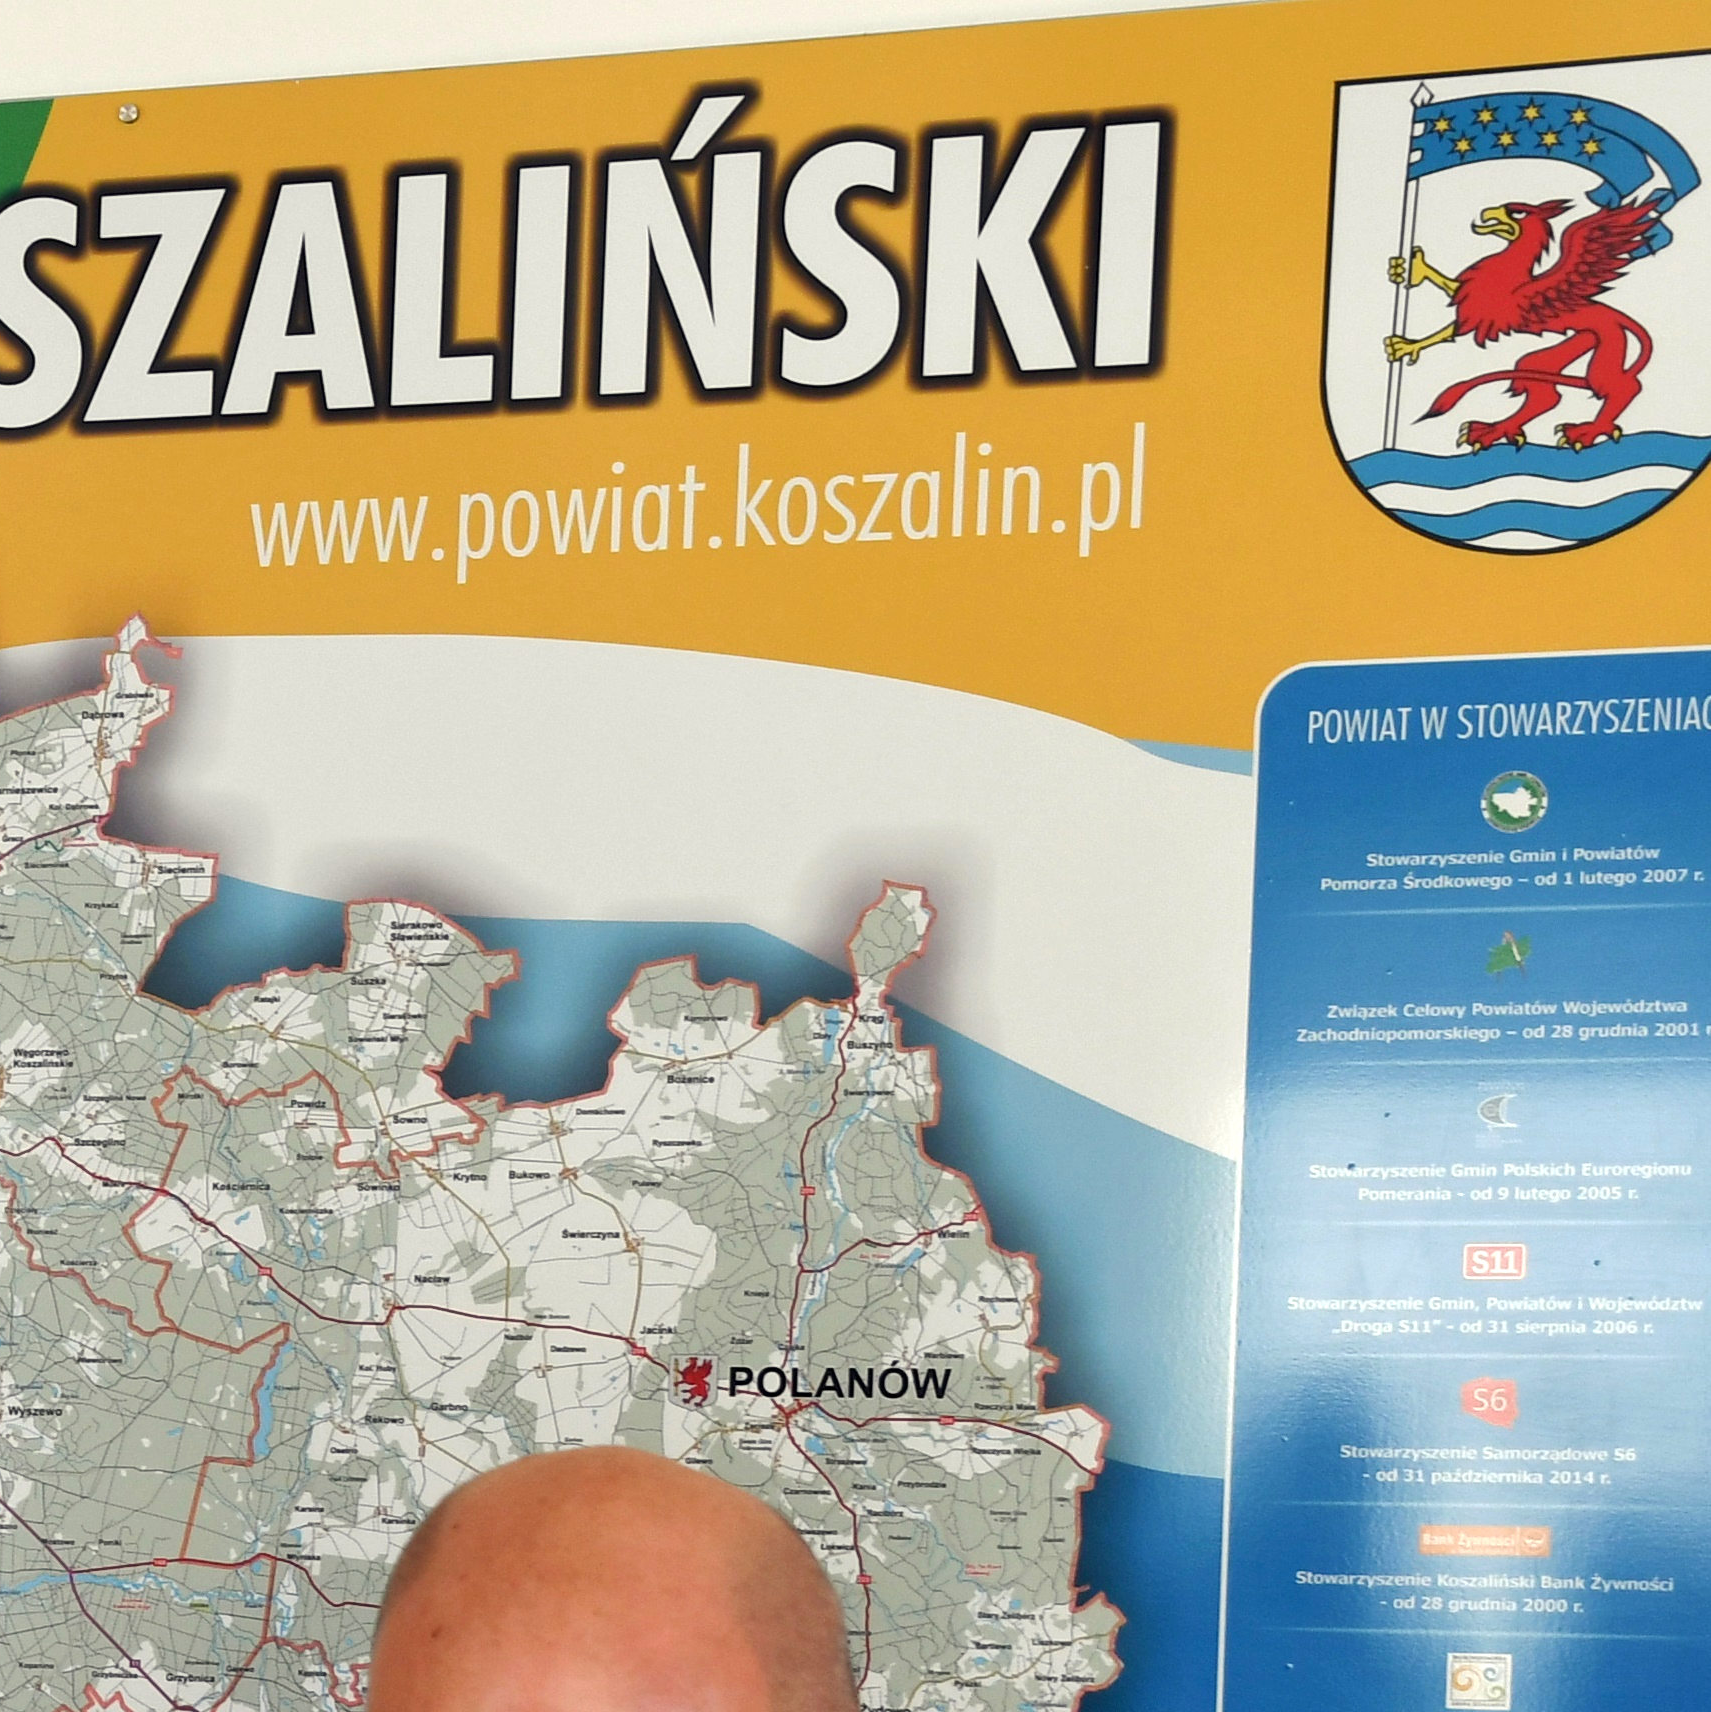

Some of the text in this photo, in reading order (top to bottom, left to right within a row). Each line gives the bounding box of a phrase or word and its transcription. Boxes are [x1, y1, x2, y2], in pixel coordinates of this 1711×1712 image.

[249, 420, 1147, 585] www.powiat.koszalin.pl
[1308, 707, 1413, 744] POWIAT
[1420, 706, 1449, 740] W
[1366, 844, 1661, 868] Stowarzyszenie Gmin i Powiatów
[1320, 868, 1705, 891] Pomorza Środkowego od 1 lutego 2007 r.
[1326, 998, 1688, 1021] Związek Celowy Powiatów Województwa
[1296, 1025, 1501, 1044] Zachodniopomorskiego
[1522, 1024, 1546, 1039] od
[1550, 1024, 1574, 1038] 28
[1578, 1023, 1649, 1042] grudnia
[1654, 1022, 1699, 1037] 2001
[13, 1047, 70, 1060] Węgorzewo
[508, 1171, 551, 1181] Bukowo
[1308, 1161, 1692, 1181] Stowarzyszenie Gmin Polskich Euroregionu
[1358, 1186, 1639, 1204] Pomerania od 9 lutego 2005 r.
[561, 1228, 621, 1242] Świerczyna
[1471, 1250, 1519, 1278] S11
[1287, 1295, 1704, 1314] Stowarzyszenie Gmin, Powiatów i Województw
[1459, 1319, 1483, 1334] od
[1487, 1319, 1509, 1334] 31
[1515, 1319, 1587, 1337] sierpnia
[1592, 1319, 1638, 1335] 2006
[1643, 1323, 1654, 1334] r.
[728, 1361, 951, 1400] POLANÓW
[430, 1402, 469, 1413] Garbno
[1472, 1388, 1508, 1412] S6
[7, 1406, 63, 1419] Wyszewo
[1339, 1444, 1637, 1464] Stowarzyszenie Samorządowe S6
[1375, 1468, 1612, 1486] od 31 października 2014 r.
[1295, 1570, 1674, 1593] Stowarzyszenie Koszaliński Bank Żywności
[1393, 1595, 1584, 1614] od 28 grudnia 2000 r.
